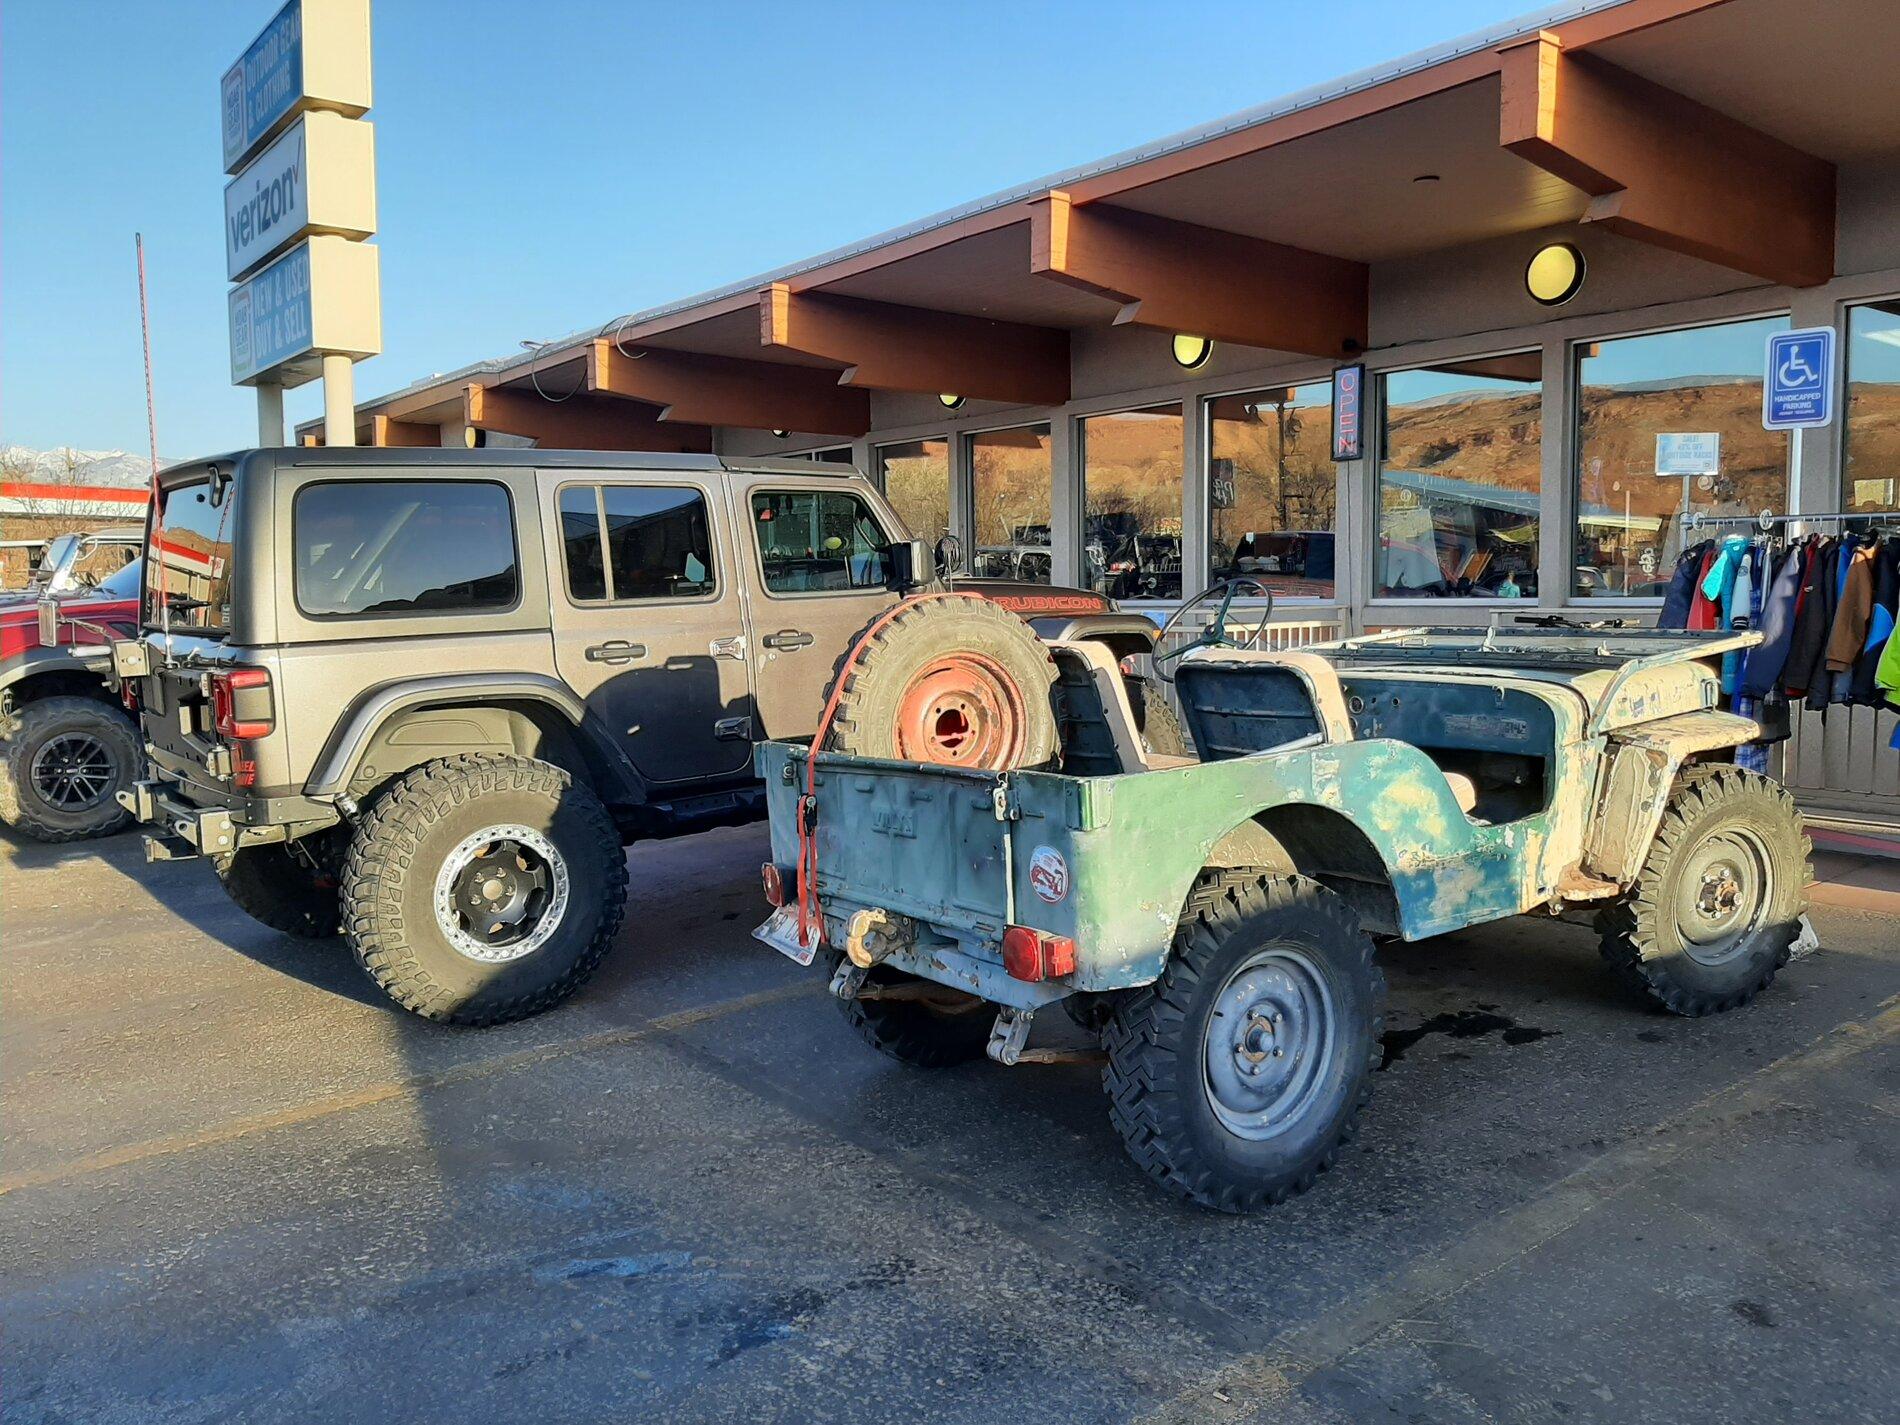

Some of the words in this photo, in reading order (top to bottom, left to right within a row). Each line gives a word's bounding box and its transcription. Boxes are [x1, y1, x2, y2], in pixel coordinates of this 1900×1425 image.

[246, 33, 279, 92] OUTDOOR
[280, 8, 302, 56] GEAR
[255, 61, 291, 122] CLOTHING
[231, 165, 295, 253] verizon
[254, 280, 272, 319] NEW
[275, 272, 283, 306] &
[285, 255, 309, 301] USED
[256, 322, 272, 358] BUY
[275, 315, 283, 349] &
[285, 301, 308, 344] SELL
[1338, 372, 1357, 456] OPEN
[1774, 391, 1821, 402] HANDICAPPED
[1782, 401, 1812, 411] PARKING
[993, 596, 1103, 610] RUBICON
